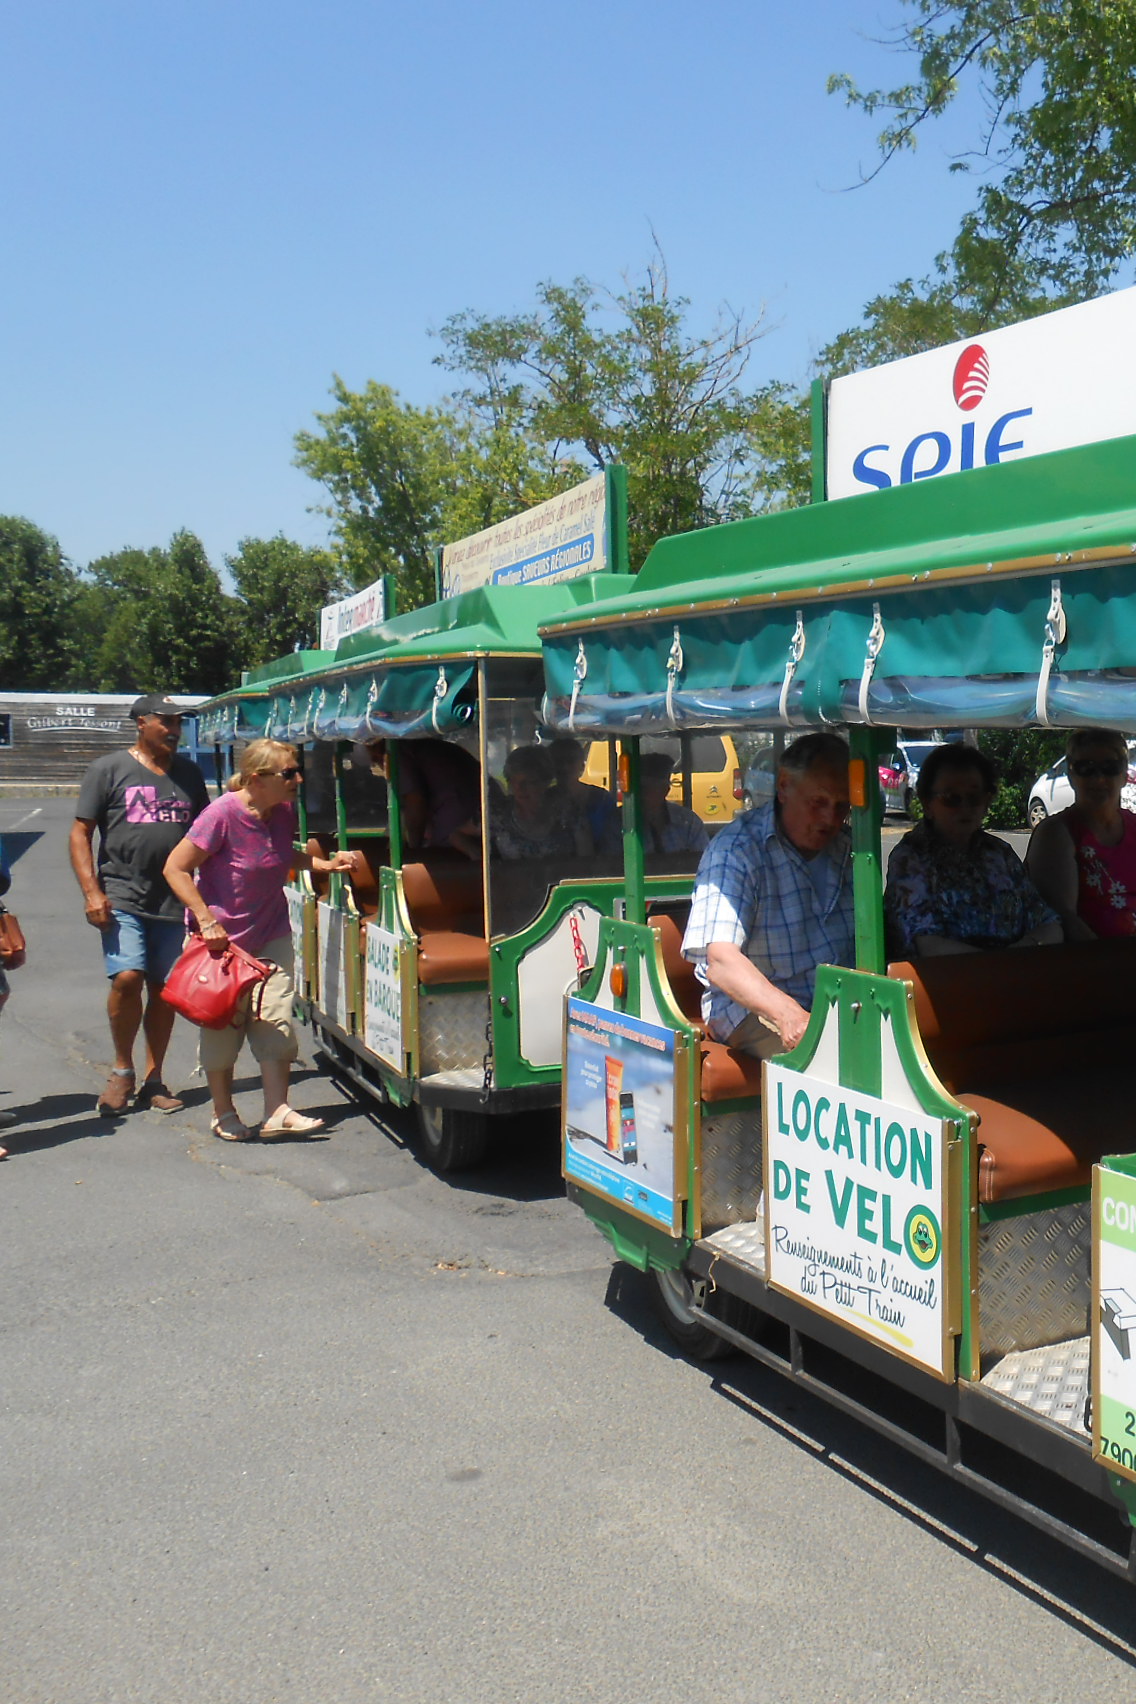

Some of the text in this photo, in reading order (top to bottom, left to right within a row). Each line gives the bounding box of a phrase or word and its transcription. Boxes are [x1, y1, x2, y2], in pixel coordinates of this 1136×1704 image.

[522, 555, 551, 583] SAVEURS
[550, 540, 592, 572] RÉGIONALES
[27, 716, 73, 728] Gilbert
[55, 706, 96, 717] SALLE
[776, 1082, 933, 1190] LOCATION
[773, 1159, 943, 1271] DE VELO
[771, 1224, 938, 1310] Renseignements à l'accueil
[800, 1266, 906, 1328] du Petit Train
